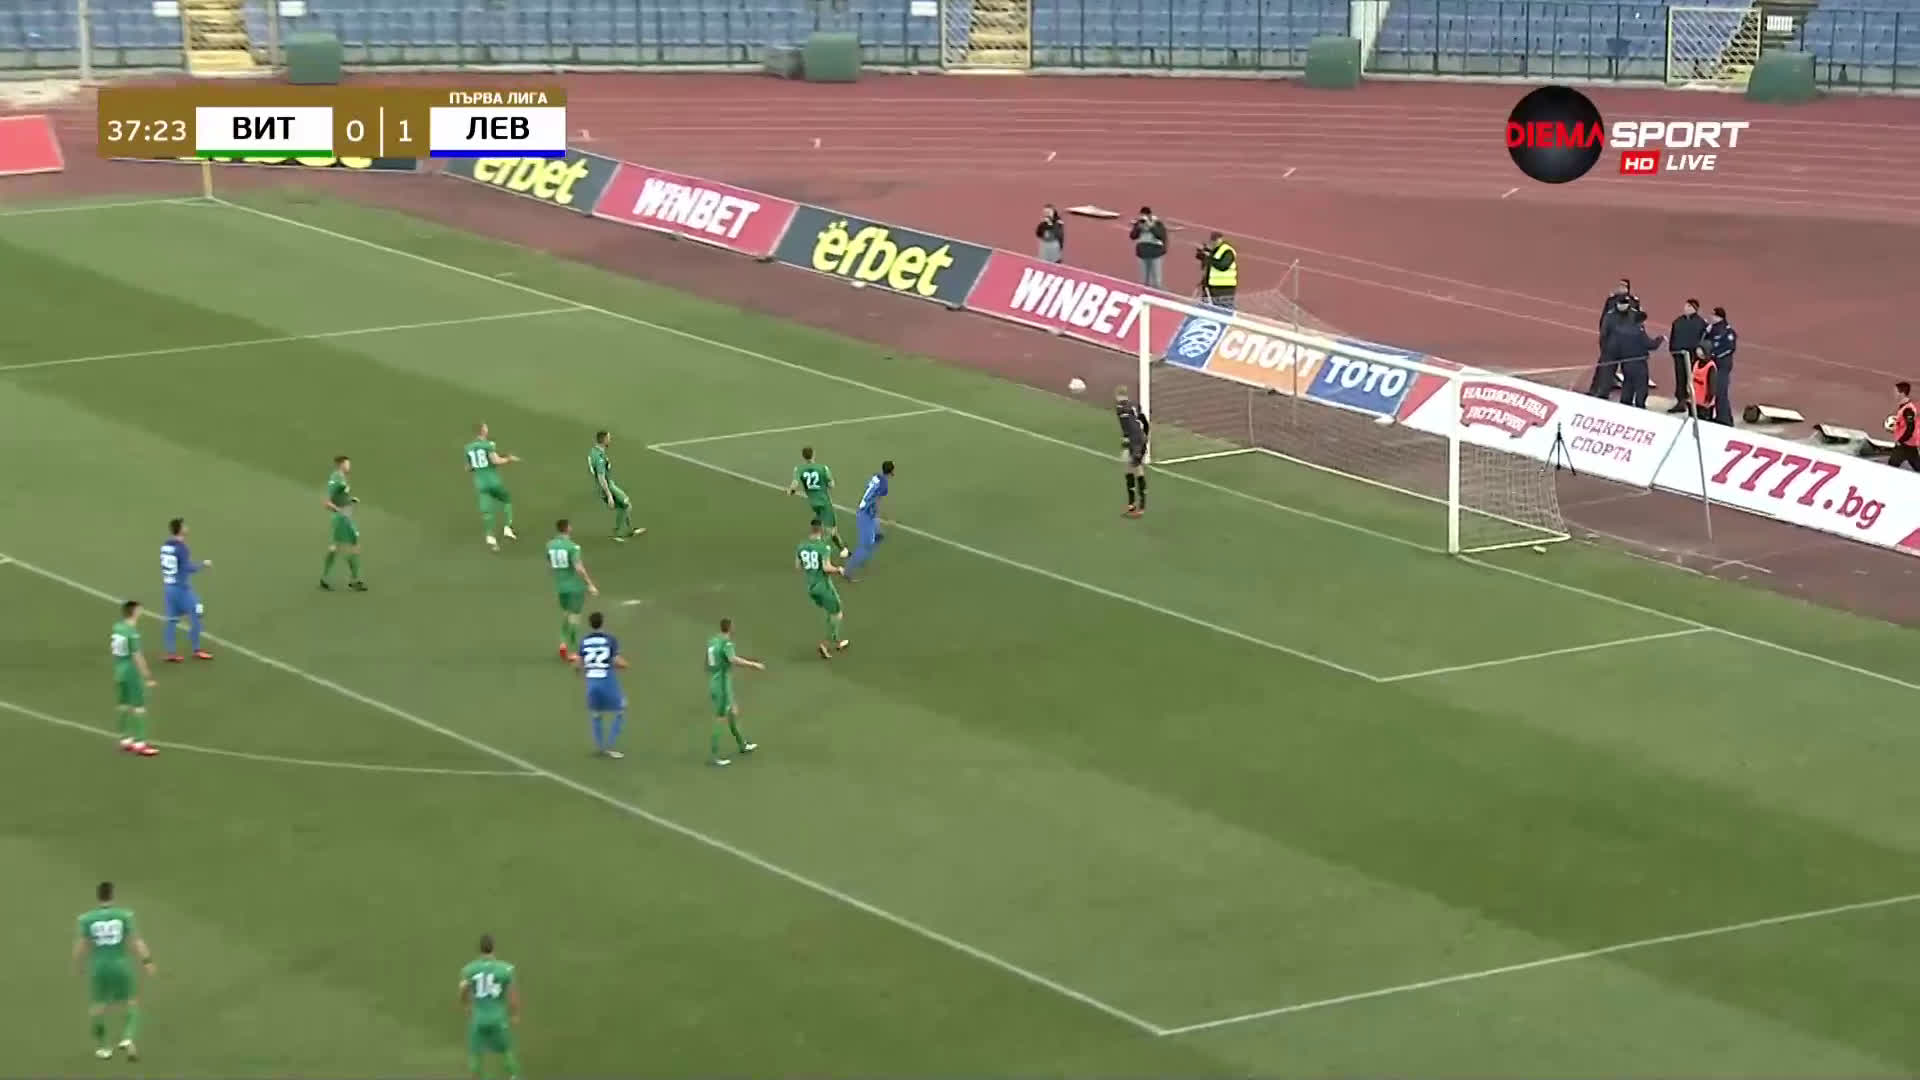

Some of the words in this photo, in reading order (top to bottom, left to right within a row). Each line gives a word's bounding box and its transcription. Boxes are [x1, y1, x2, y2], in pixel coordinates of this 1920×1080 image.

[632, 177, 761, 239] WINBET
[1009, 266, 1147, 340] WINBET
[1218, 329, 1327, 378] СПОРТ
[1324, 354, 1408, 398] ТОТО
[1570, 412, 1657, 446] ПОДКРЕПЯ
[1570, 435, 1633, 463] СПОРТА
[802, 470, 821, 490] 22
[1711, 439, 1886, 530] 7777.bg
[583, 646, 610, 668] 22
